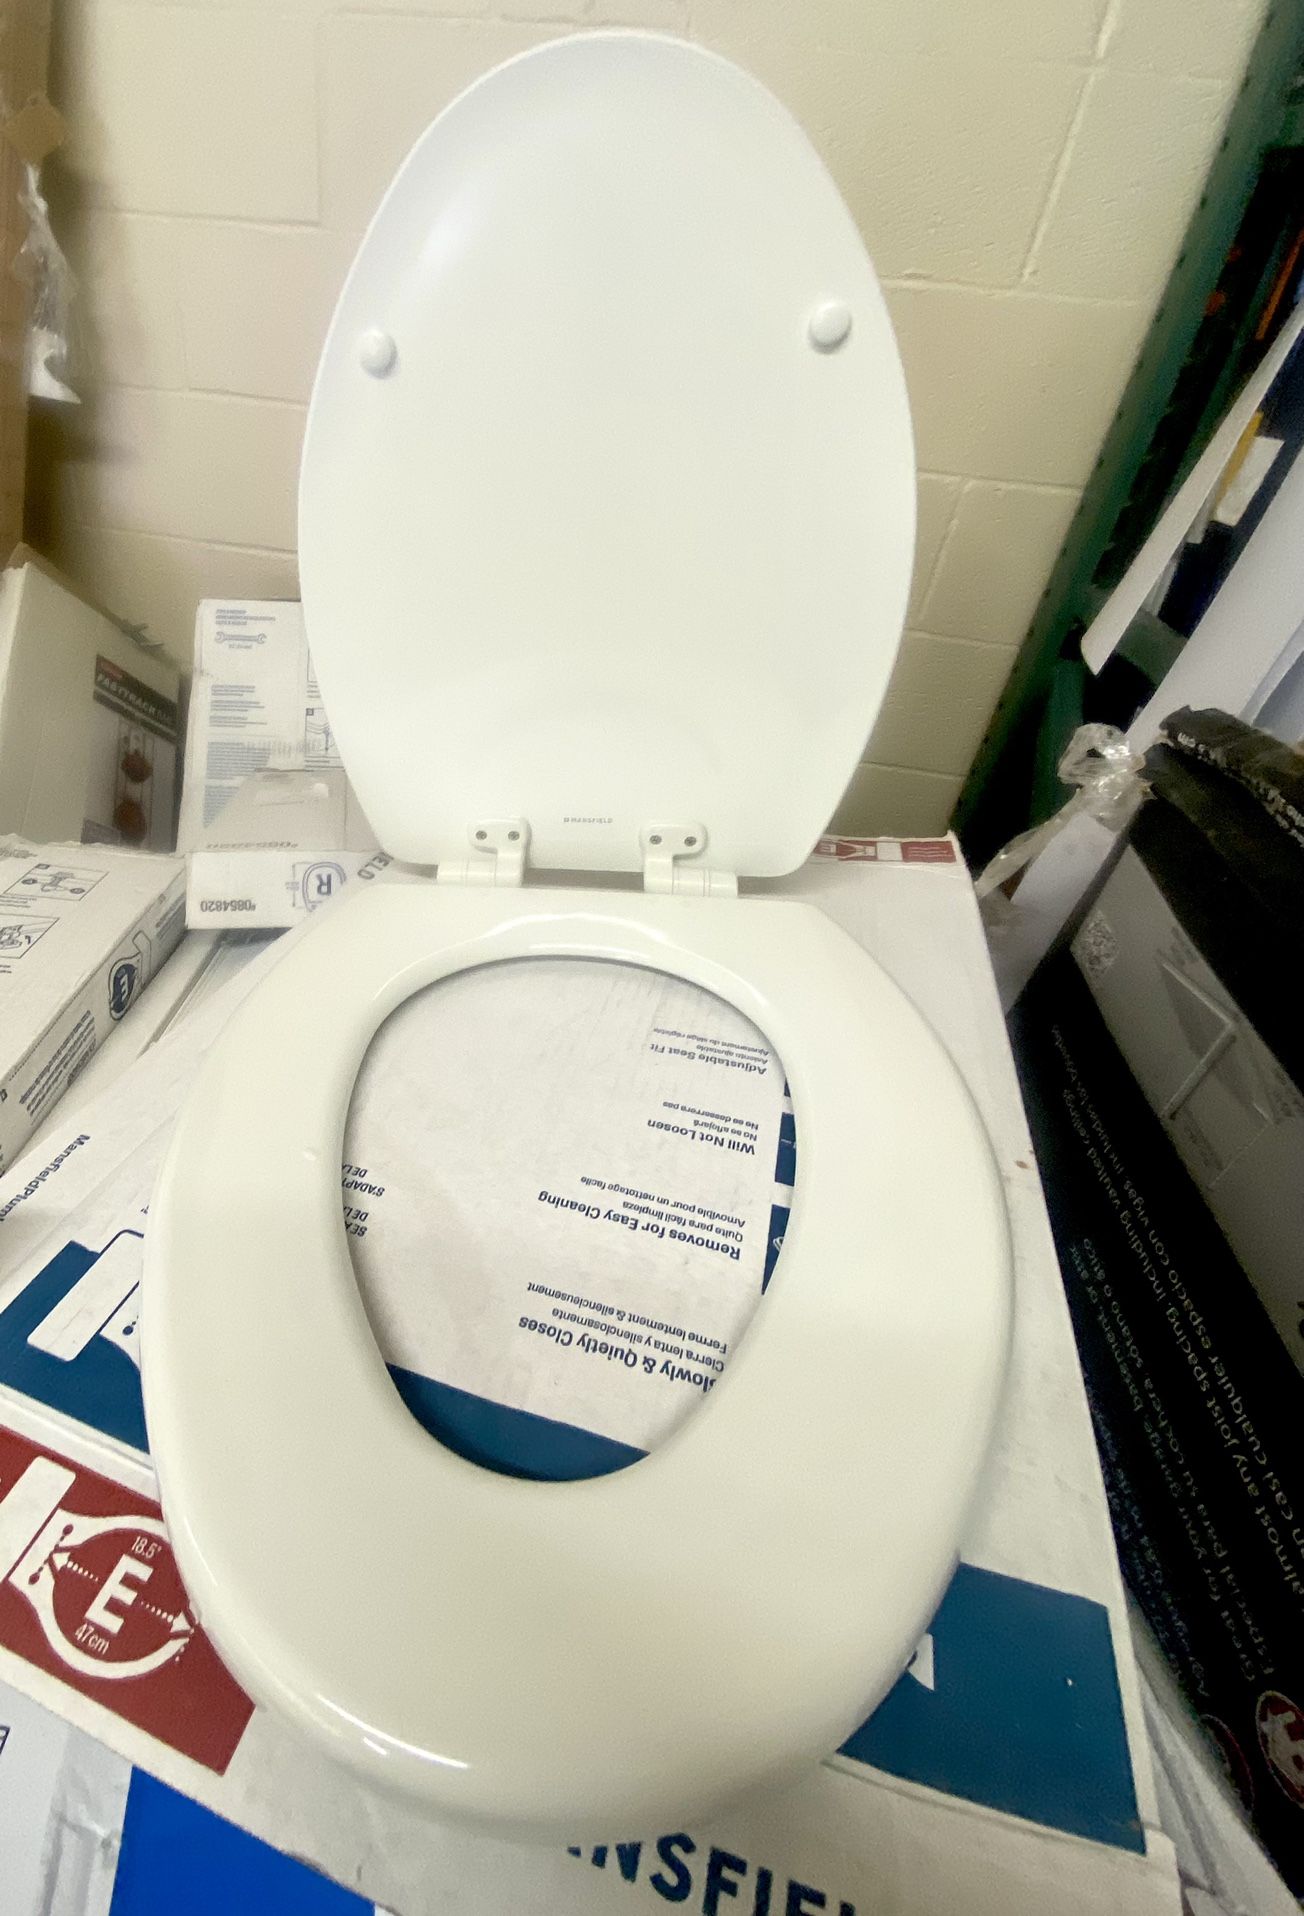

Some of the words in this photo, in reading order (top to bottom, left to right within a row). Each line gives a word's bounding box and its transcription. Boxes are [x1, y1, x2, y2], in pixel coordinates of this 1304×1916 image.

[316, 873, 332, 896] R
[650, 1044, 665, 1053] Fit
[668, 1047, 696, 1060] Seat
[698, 1053, 767, 1075] Adjustable
[662, 1101, 680, 1110] pas
[647, 1119, 696, 1140] Loosen
[730, 1128, 742, 1136] se
[745, 1121, 759, 1131] Ne
[699, 1132, 724, 1147] Not
[727, 1139, 755, 1155] Will
[743, 1132, 757, 1142] No
[353, 1167, 368, 1178] DE
[580, 1176, 606, 1190] facile
[1085, 1146, 1122, 1210] vaulted
[538, 1191, 601, 1219] Cleaning
[623, 1201, 664, 1220] limpieza
[656, 1196, 669, 1205] un
[670, 1201, 696, 1213] pour
[353, 1209, 369, 1222] DE
[603, 1209, 639, 1231] Easy
[664, 1213, 686, 1227] fácil
[688, 1220, 714, 1232] para
[697, 1208, 746, 1228] Amovible
[641, 1222, 665, 1239] for
[715, 1227, 743, 1242] Quite
[669, 1229, 740, 1260] Removes
[1148, 1229, 1171, 1267] con
[1119, 1209, 1167, 1303] including
[527, 1282, 615, 1316] silencieusement
[1102, 1283, 1113, 1298] o
[616, 1309, 626, 1321] &
[1167, 1269, 1212, 1350] espacio
[518, 1317, 573, 1346] Closes
[552, 1308, 643, 1344] silenciosamente
[628, 1313, 686, 1341] lentement
[576, 1333, 638, 1368] Quietly
[644, 1336, 652, 1346] y
[654, 1340, 684, 1359] lenta
[688, 1332, 728, 1355] Ferme
[642, 1356, 657, 1374] &
[686, 1350, 726, 1373] Cierra
[1207, 1355, 1268, 1466] cualquier
[1206, 1396, 1241, 1448] joist
[1231, 1453, 1260, 1497] any
[1263, 1470, 1294, 1521] casi
[1254, 1504, 1304, 1595] almost
[84, 1553, 154, 1635] E
[1202, 1567, 1222, 1603] for
[74, 1622, 110, 1655] 47cm
